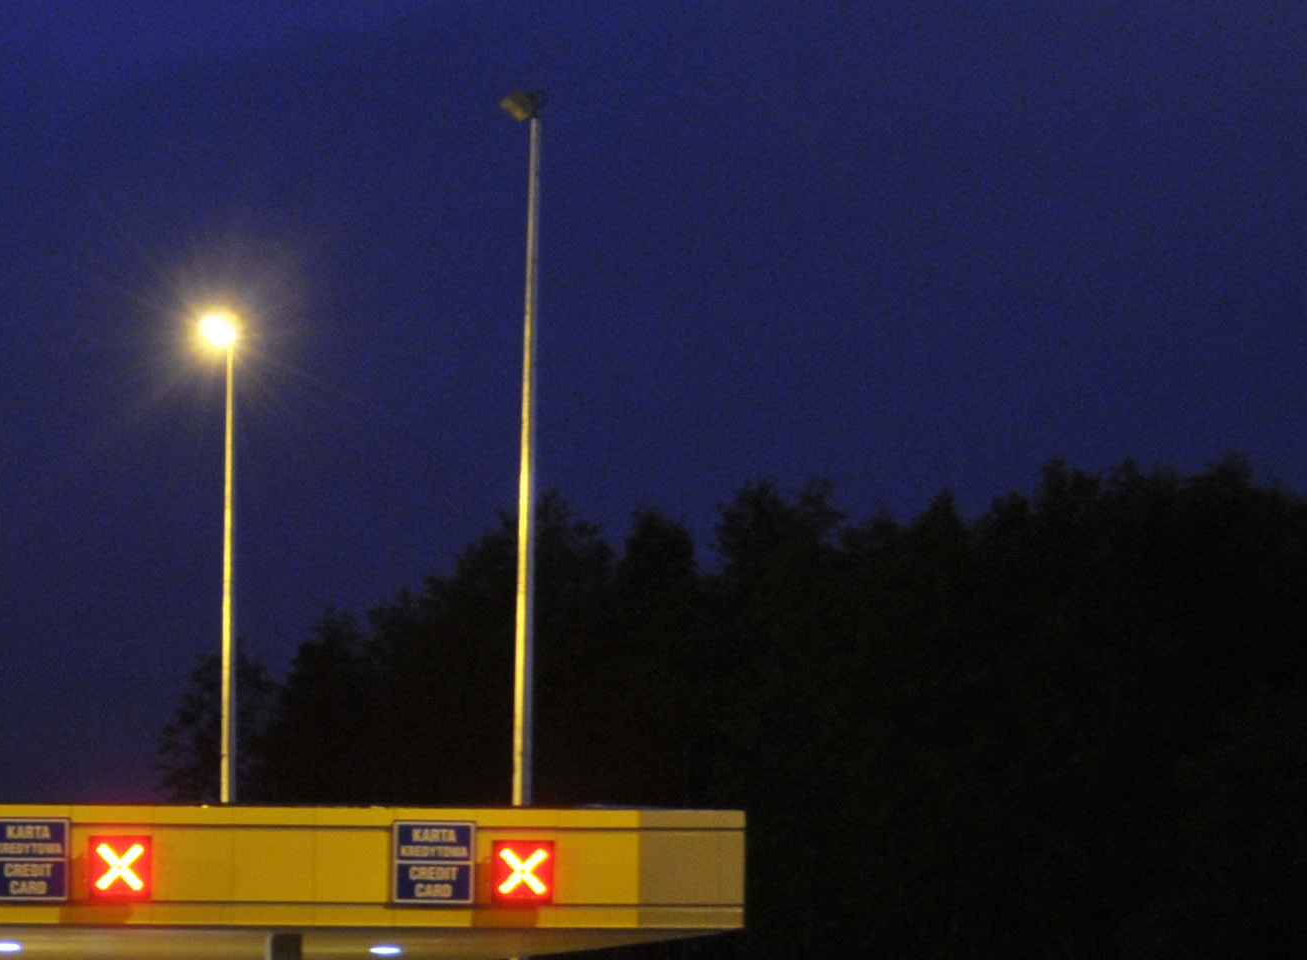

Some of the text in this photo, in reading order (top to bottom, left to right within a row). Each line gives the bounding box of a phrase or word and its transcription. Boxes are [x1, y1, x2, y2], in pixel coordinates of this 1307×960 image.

[6, 825, 51, 839] KARTA
[412, 828, 457, 842] KARTA
[3, 863, 53, 877] CREDIT
[409, 866, 458, 880] CREDIT
[10, 881, 47, 894] CARD
[415, 884, 453, 898] CARD
